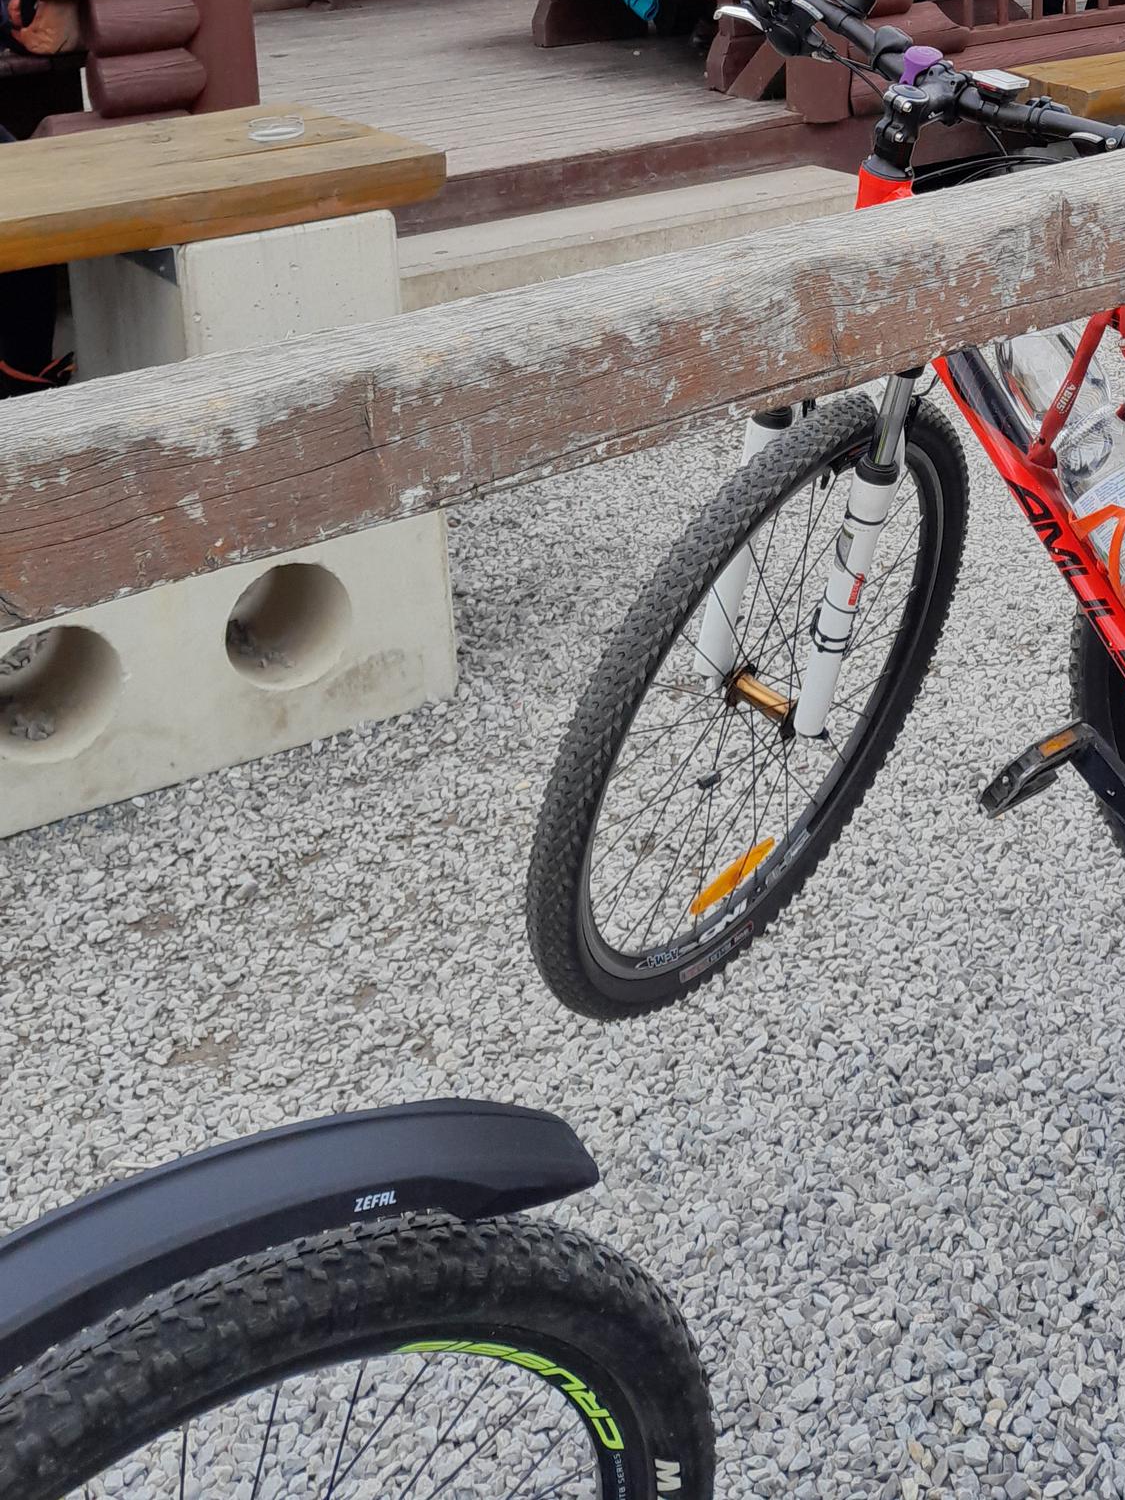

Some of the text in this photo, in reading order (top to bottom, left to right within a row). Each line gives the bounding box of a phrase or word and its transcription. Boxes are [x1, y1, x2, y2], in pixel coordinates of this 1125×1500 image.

[1056, 383, 1077, 412] ABUS
[354, 1190, 397, 1213] ZEFAL
[613, 1453, 625, 1484] SERIES
